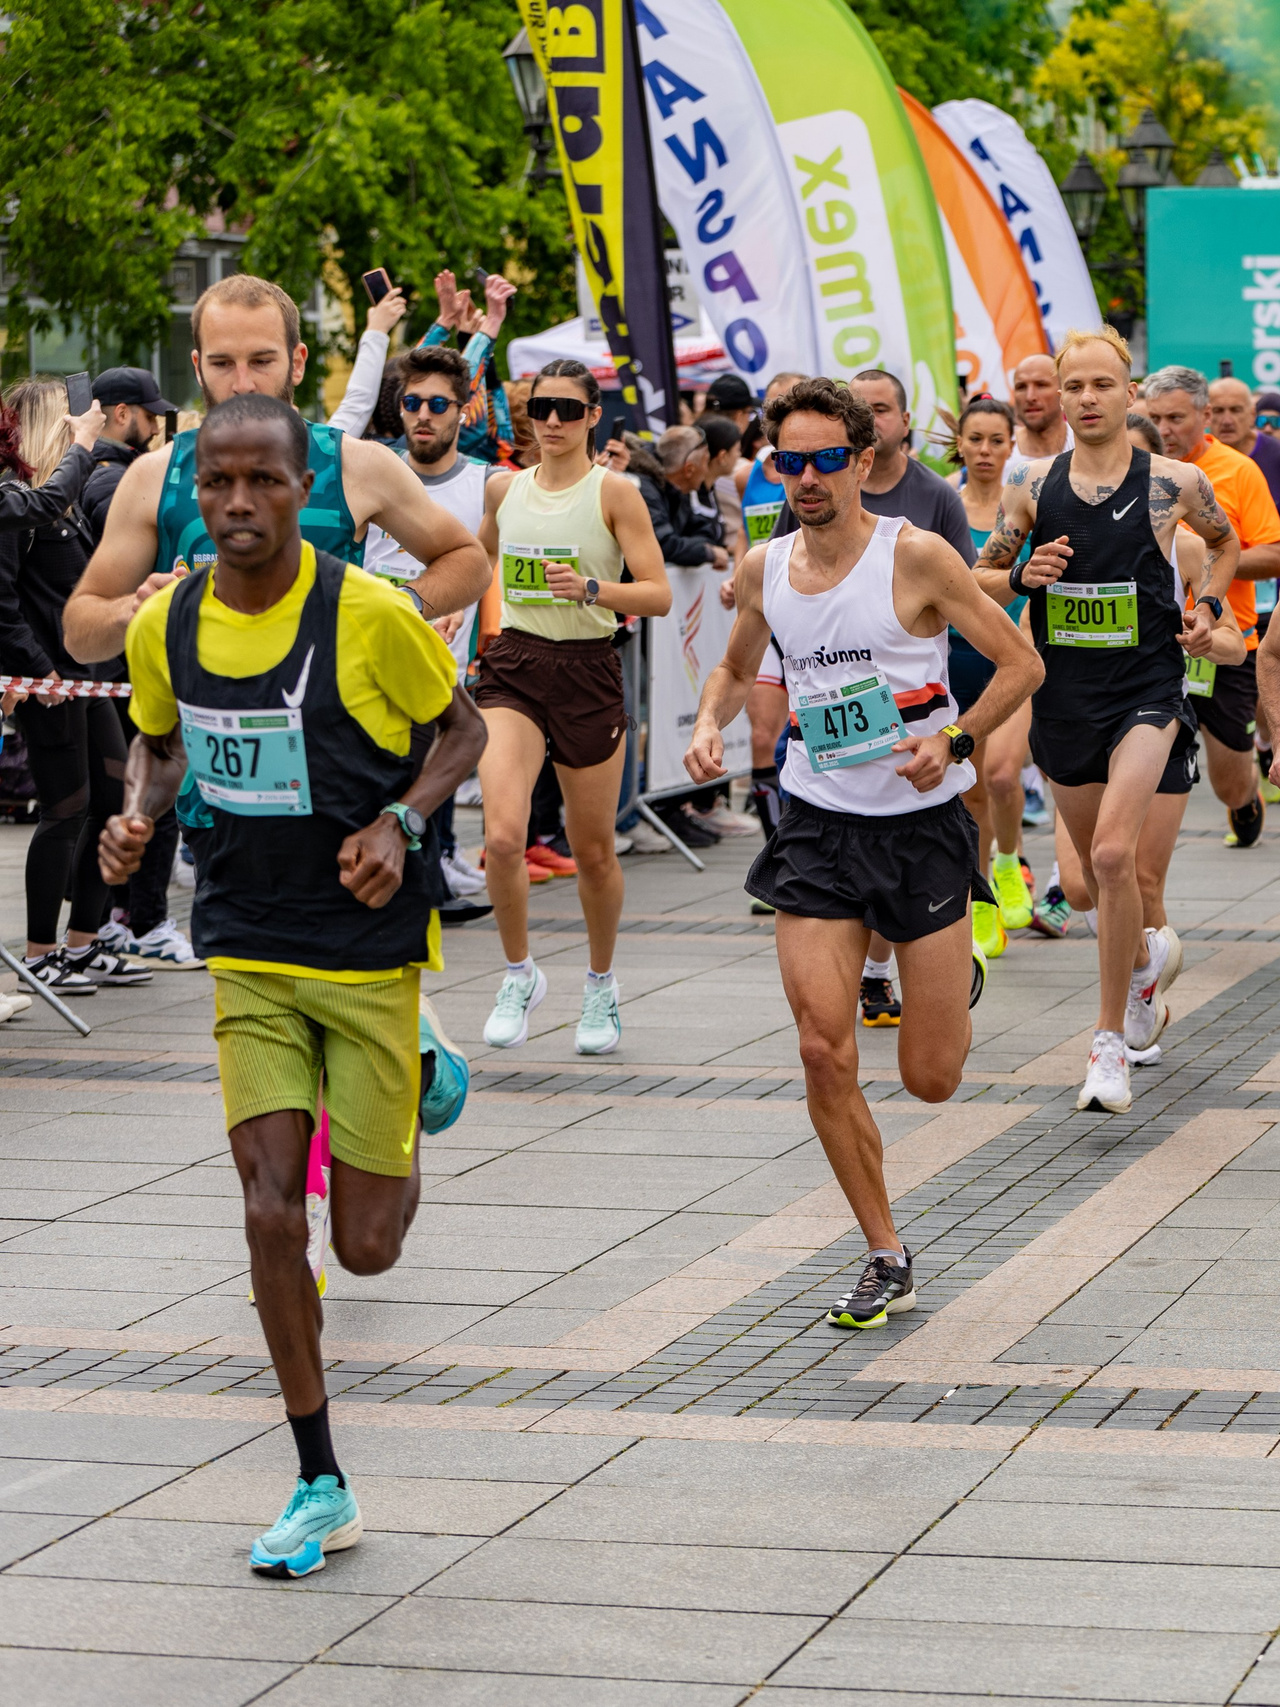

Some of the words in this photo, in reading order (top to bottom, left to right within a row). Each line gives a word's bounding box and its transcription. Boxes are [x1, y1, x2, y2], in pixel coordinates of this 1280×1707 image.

[515, 558, 561, 583] 211
[1064, 598, 1117, 625] 2001
[824, 700, 869, 739] 473
[206, 735, 261, 778] 267
